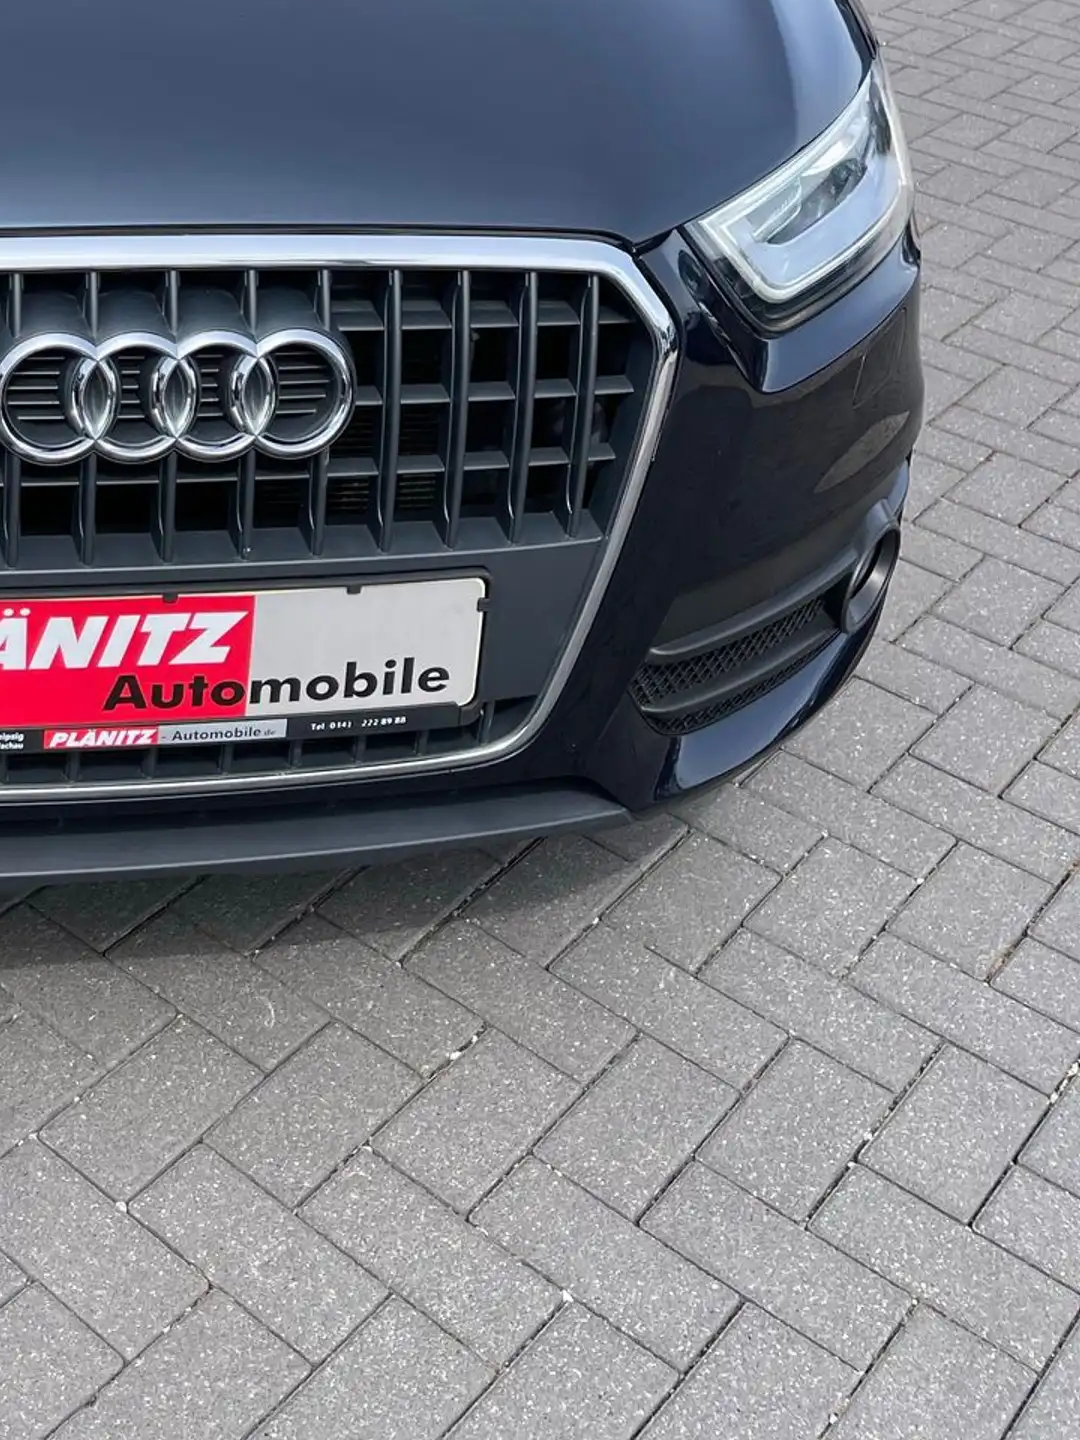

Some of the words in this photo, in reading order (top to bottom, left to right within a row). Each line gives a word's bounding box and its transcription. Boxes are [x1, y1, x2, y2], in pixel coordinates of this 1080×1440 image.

[104, 657, 450, 712] Automobile
[49, 729, 158, 748] PLÄNITZ
[171, 727, 262, 742] Automobile
